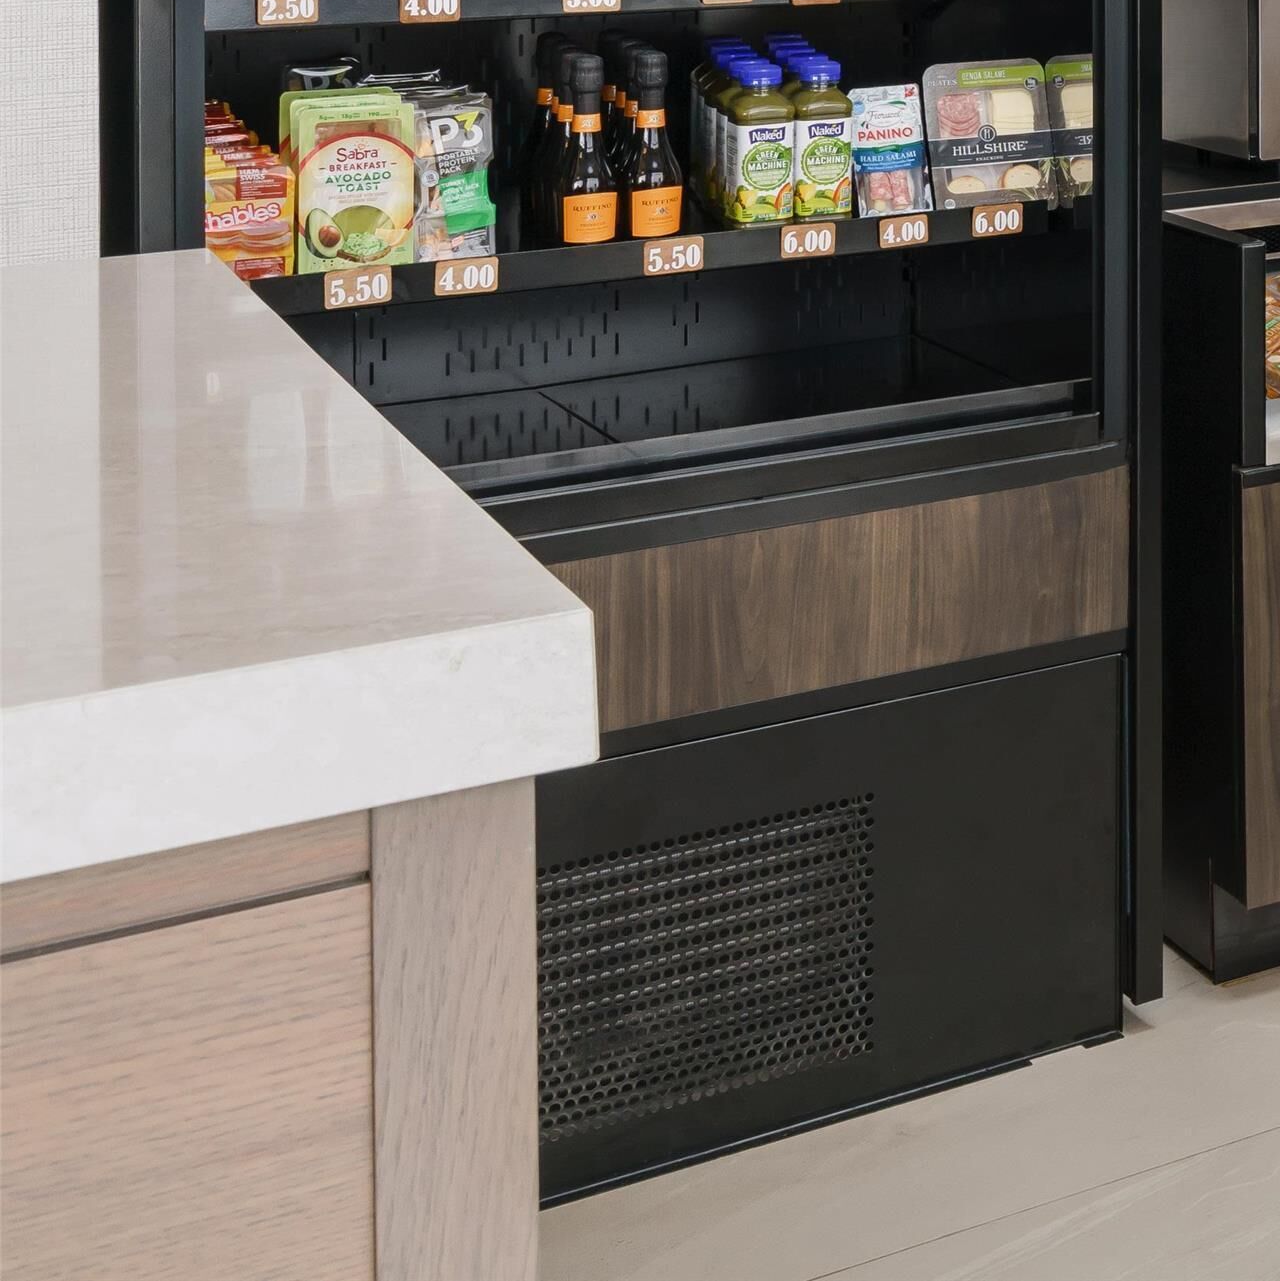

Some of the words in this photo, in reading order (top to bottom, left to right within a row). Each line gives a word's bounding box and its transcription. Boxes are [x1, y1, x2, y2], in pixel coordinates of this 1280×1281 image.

[750, 128, 784, 143] Naked
[857, 126, 914, 142] PANINO
[335, 146, 379, 163] Sabra
[859, 153, 882, 163] HARD
[883, 150, 918, 162] SALAMI
[952, 140, 1026, 158] HILLSHIRE
[328, 160, 388, 173] BREAKFAST
[747, 160, 788, 172] MACHINE
[324, 170, 392, 186] AVOCADO
[336, 181, 381, 193] TOAST
[974, 208, 1020, 234] 6.00
[882, 220, 926, 245] 4.00
[783, 229, 833, 254] 6.00
[647, 243, 702, 273] 5.50
[438, 263, 495, 291] 4.00
[329, 273, 389, 306] 5.50
